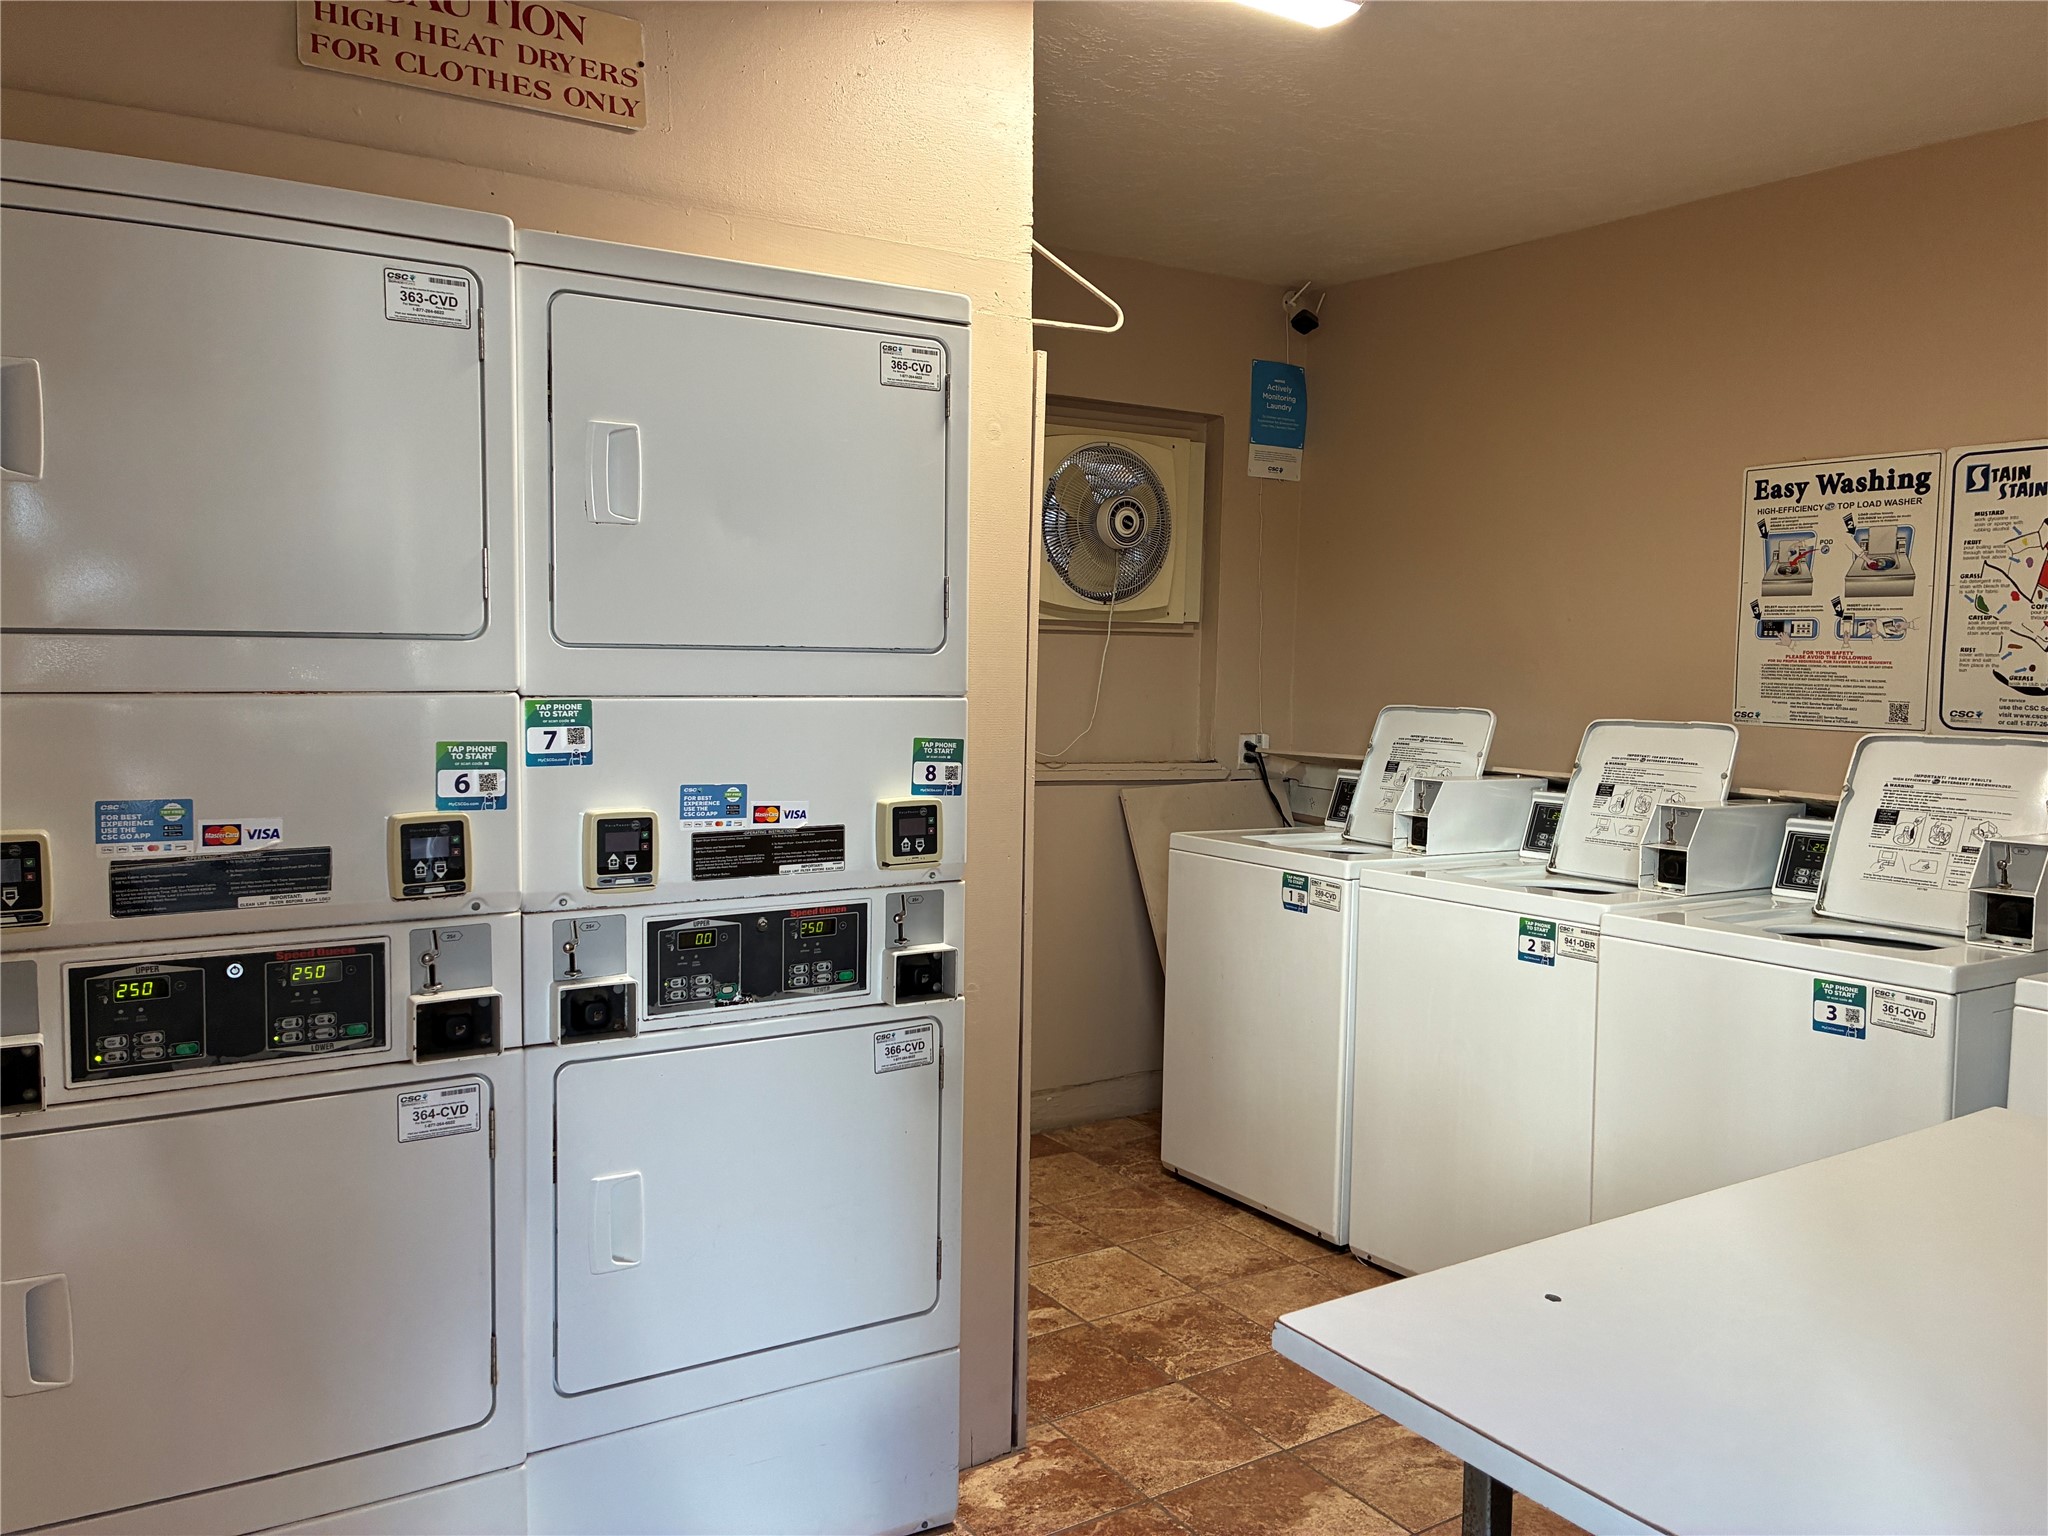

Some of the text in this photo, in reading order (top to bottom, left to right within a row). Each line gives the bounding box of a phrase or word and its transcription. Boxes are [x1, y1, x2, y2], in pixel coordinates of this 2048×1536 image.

[313, 1, 638, 88] HIGH HEAT DRYERS
[310, 33, 640, 118] FOR CLOTHES ONLY
[387, 272, 408, 281] CSC
[399, 290, 458, 308] 363-CVD
[891, 360, 932, 373] 365-CVD
[1267, 384, 1292, 394] Actively
[1263, 392, 1297, 404] Monitoring
[1266, 402, 1292, 412] Laundry
[1754, 467, 1932, 504] Easy Washing
[1757, 497, 1922, 516] HIGH-EFFICIENCY TOP LOAD WASHER
[1847, 520, 1854, 529] 2
[1949, 710, 1975, 718] CSC
[543, 730, 557, 750] 7
[925, 764, 937, 782] 8
[454, 773, 470, 794] 6
[101, 813, 119, 821] FOR
[783, 809, 807, 820] VISA
[204, 831, 240, 839] MasterCard
[246, 828, 280, 840] VISA
[1288, 890, 1293, 901] 1
[790, 908, 818, 917] Speed
[693, 919, 710, 927] UPPER
[801, 921, 823, 934] 250
[695, 932, 712, 945] 00
[1564, 937, 1595, 950] 941-DBR
[1527, 938, 1536, 952] 2
[275, 946, 356, 961] Speed Queen
[135, 965, 160, 975] UPPER
[292, 964, 325, 981] 250
[116, 981, 153, 998] 250
[1834, 989, 1855, 998] START
[1835, 984, 1858, 993] PHONE
[1875, 989, 1891, 997] CSC
[1826, 1005, 1837, 1021] 3
[1882, 1003, 1926, 1021] 361-CVD
[876, 1033, 891, 1041] CSC
[311, 1042, 334, 1052] LOWER
[884, 1041, 925, 1056] 366-CVD
[400, 1094, 421, 1104] CSC
[412, 1104, 469, 1122] 364-CVD
